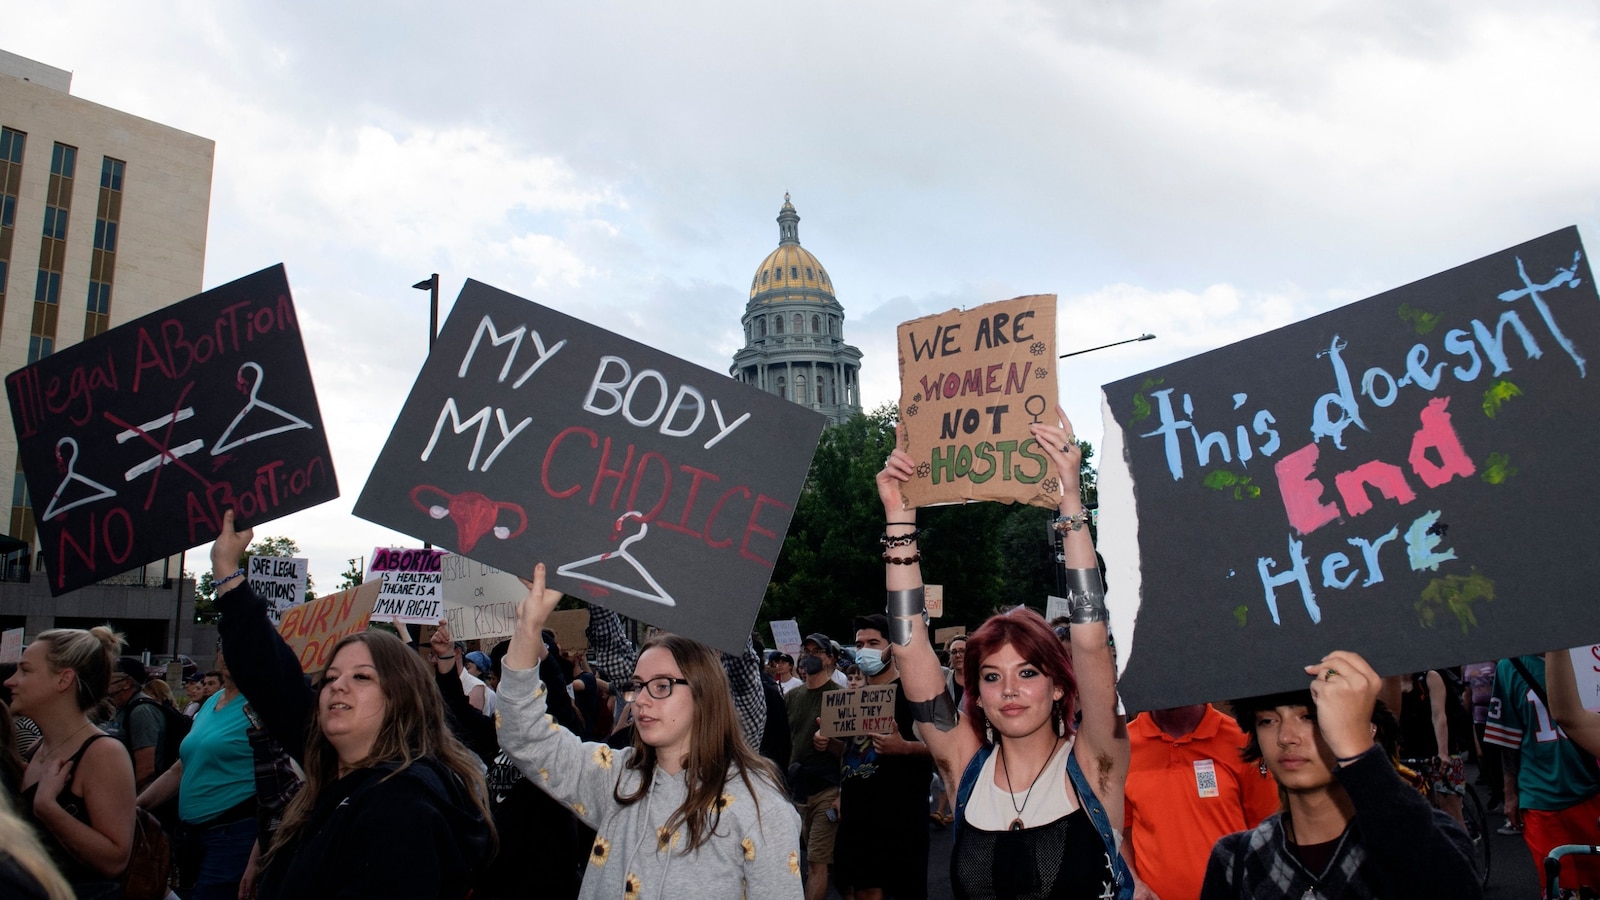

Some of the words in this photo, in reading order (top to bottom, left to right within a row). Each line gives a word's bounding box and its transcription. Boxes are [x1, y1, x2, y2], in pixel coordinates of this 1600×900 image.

[909, 324, 961, 362] WE
[974, 310, 1035, 351] ARE
[459, 315, 567, 389] MY
[582, 354, 751, 449] BODY
[919, 361, 1033, 401] WOMEN
[939, 404, 1009, 440] NOT
[930, 438, 1048, 486] HOSTS
[1274, 395, 1477, 536] End
[420, 396, 533, 472] MY
[541, 425, 792, 568] CHOICE
[58, 507, 135, 588] NO
[371, 549, 441, 572] ABORTIO
[273, 560, 298, 579] LEGAL
[250, 579, 296, 602] ABORTIONS
[415, 585, 426, 596] IS
[426, 586, 435, 596] A
[474, 586, 485, 597] OR
[281, 588, 358, 641] BURN
[372, 599, 406, 614] UMAN
[404, 599, 440, 618] RIGHT.
[826, 691, 856, 707] WHAT
[860, 689, 894, 703] RIGHTS
[838, 707, 857, 719] WILL
[859, 705, 882, 717] THEY
[833, 718, 856, 732] TAKE
[862, 716, 894, 731] NEXT?
